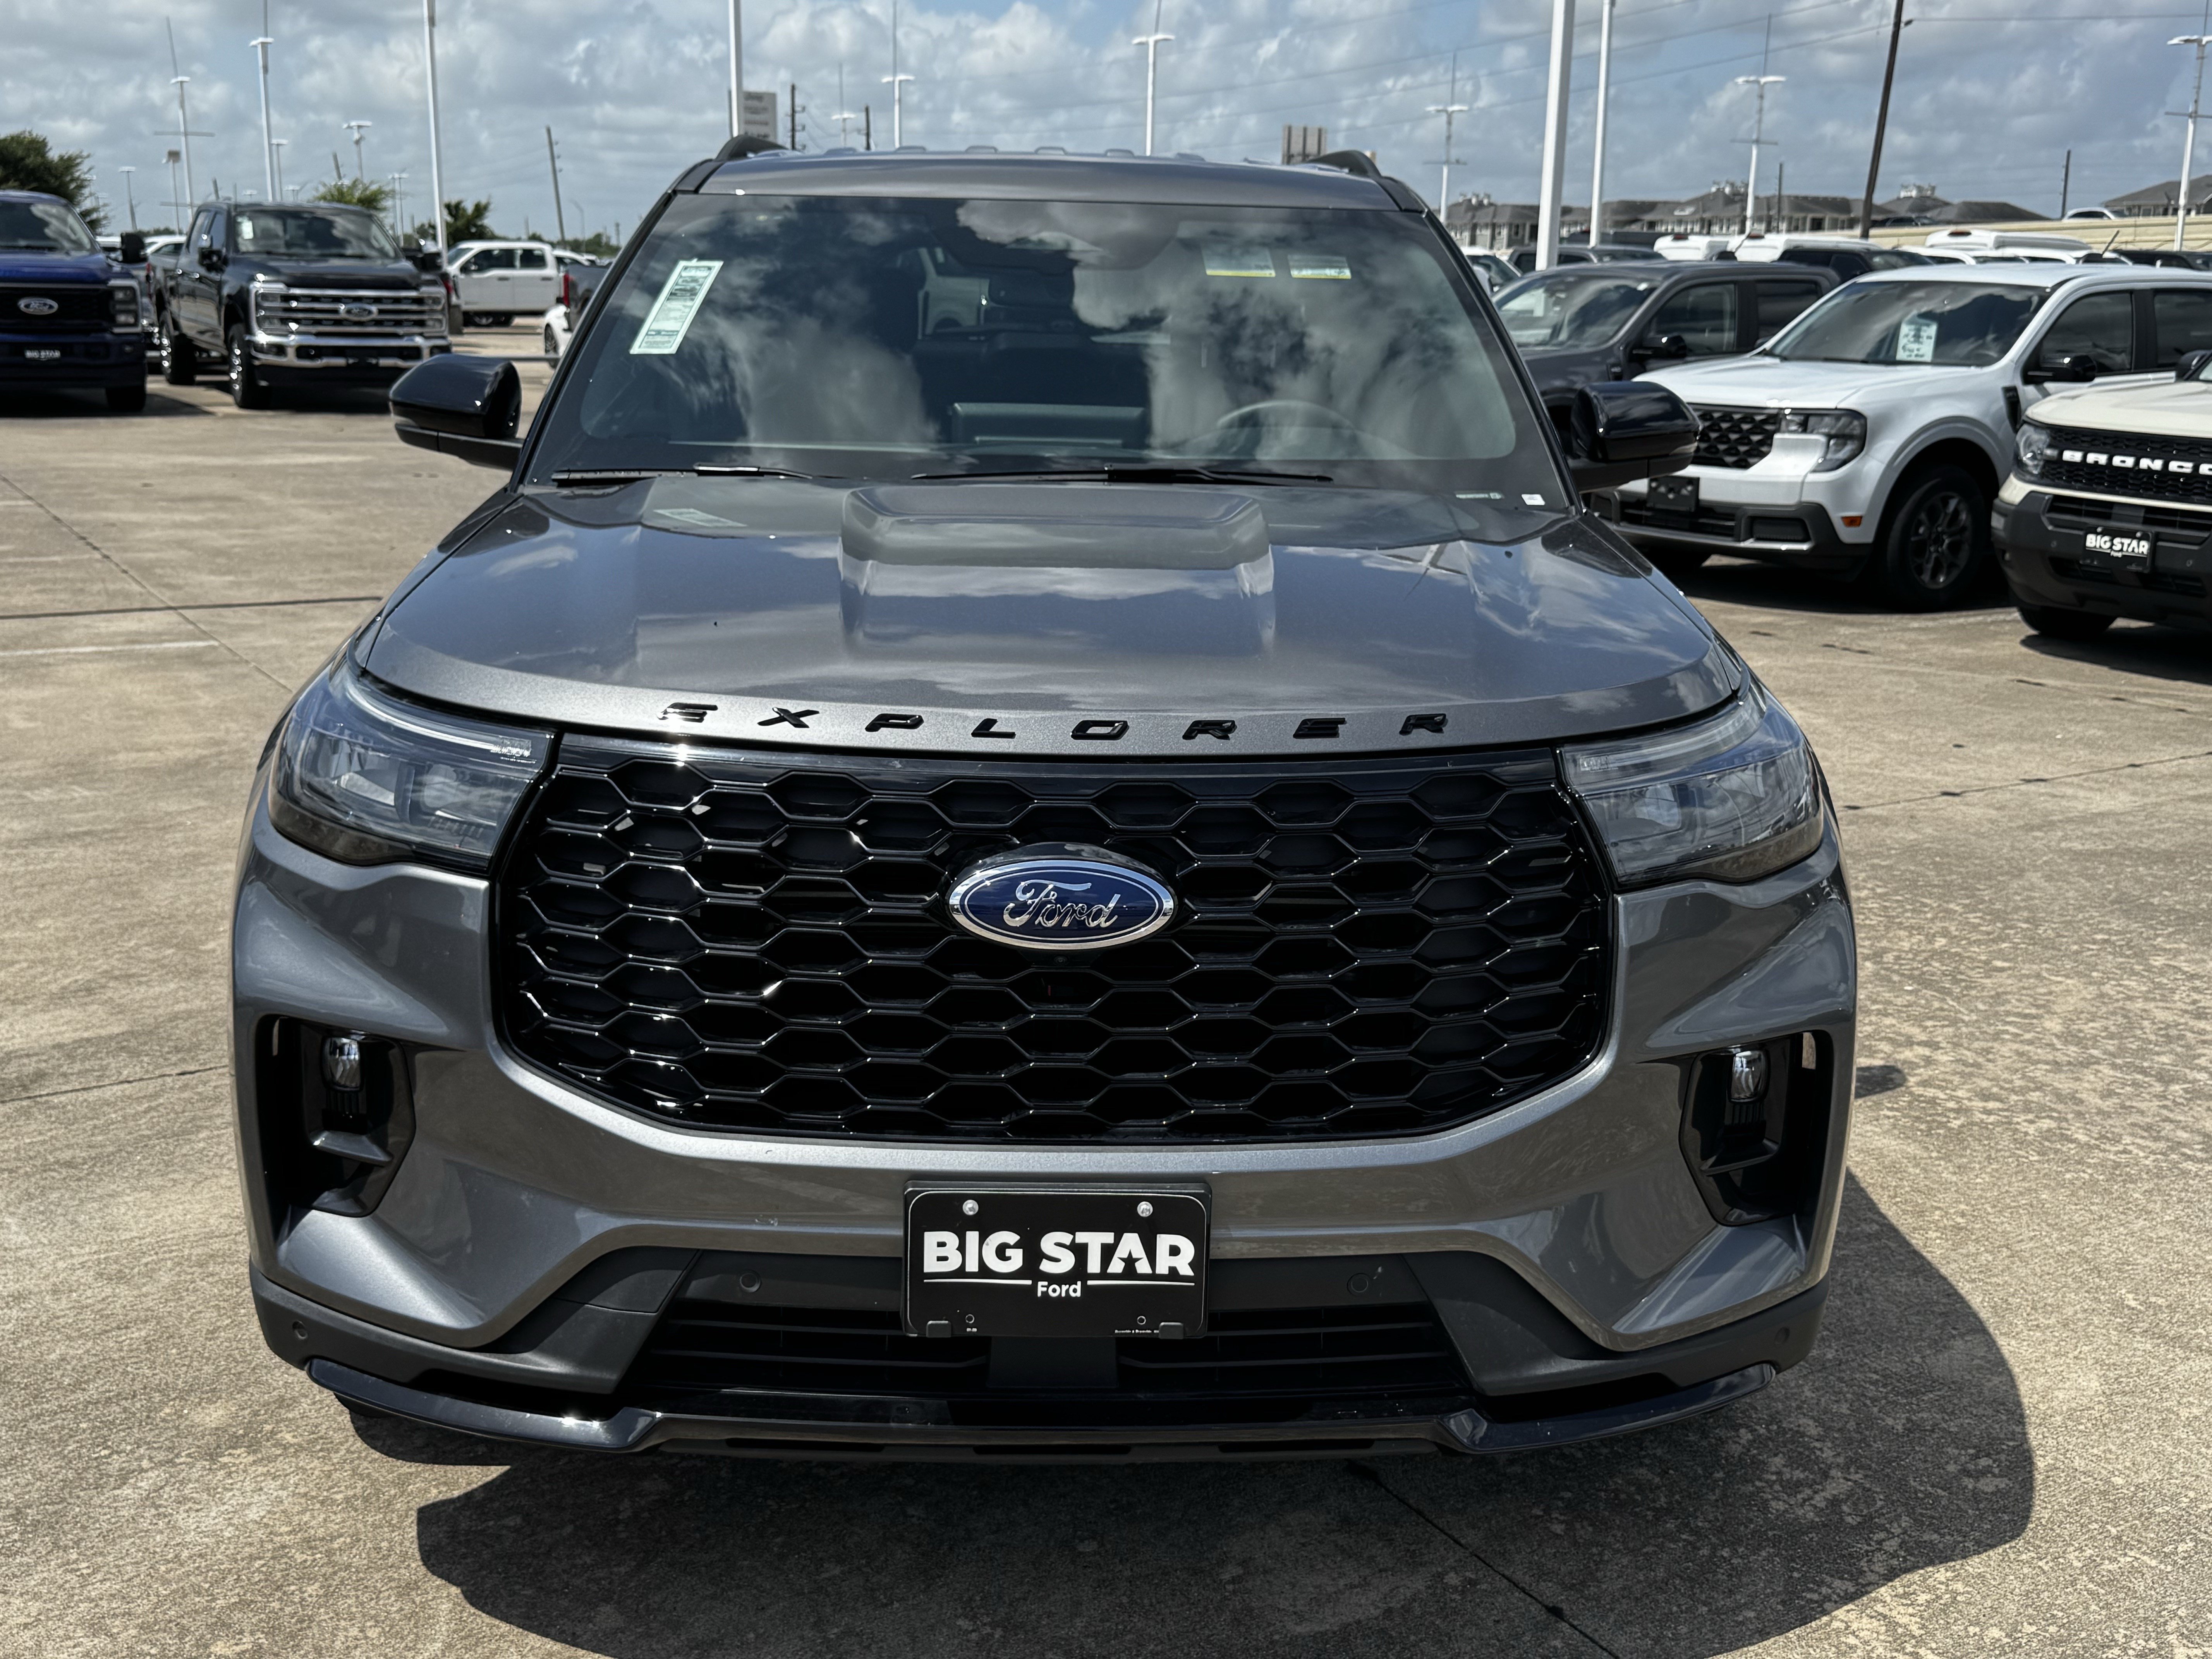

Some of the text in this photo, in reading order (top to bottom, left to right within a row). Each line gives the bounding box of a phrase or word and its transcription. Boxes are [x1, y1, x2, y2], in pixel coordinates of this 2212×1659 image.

[2086, 534, 2149, 555] BIG STAR
[657, 702, 1447, 740] EXPLORER
[1003, 879, 1121, 928] Ford
[924, 1231, 1195, 1276] BIG STAR
[1037, 1281, 1082, 1297] Ford
